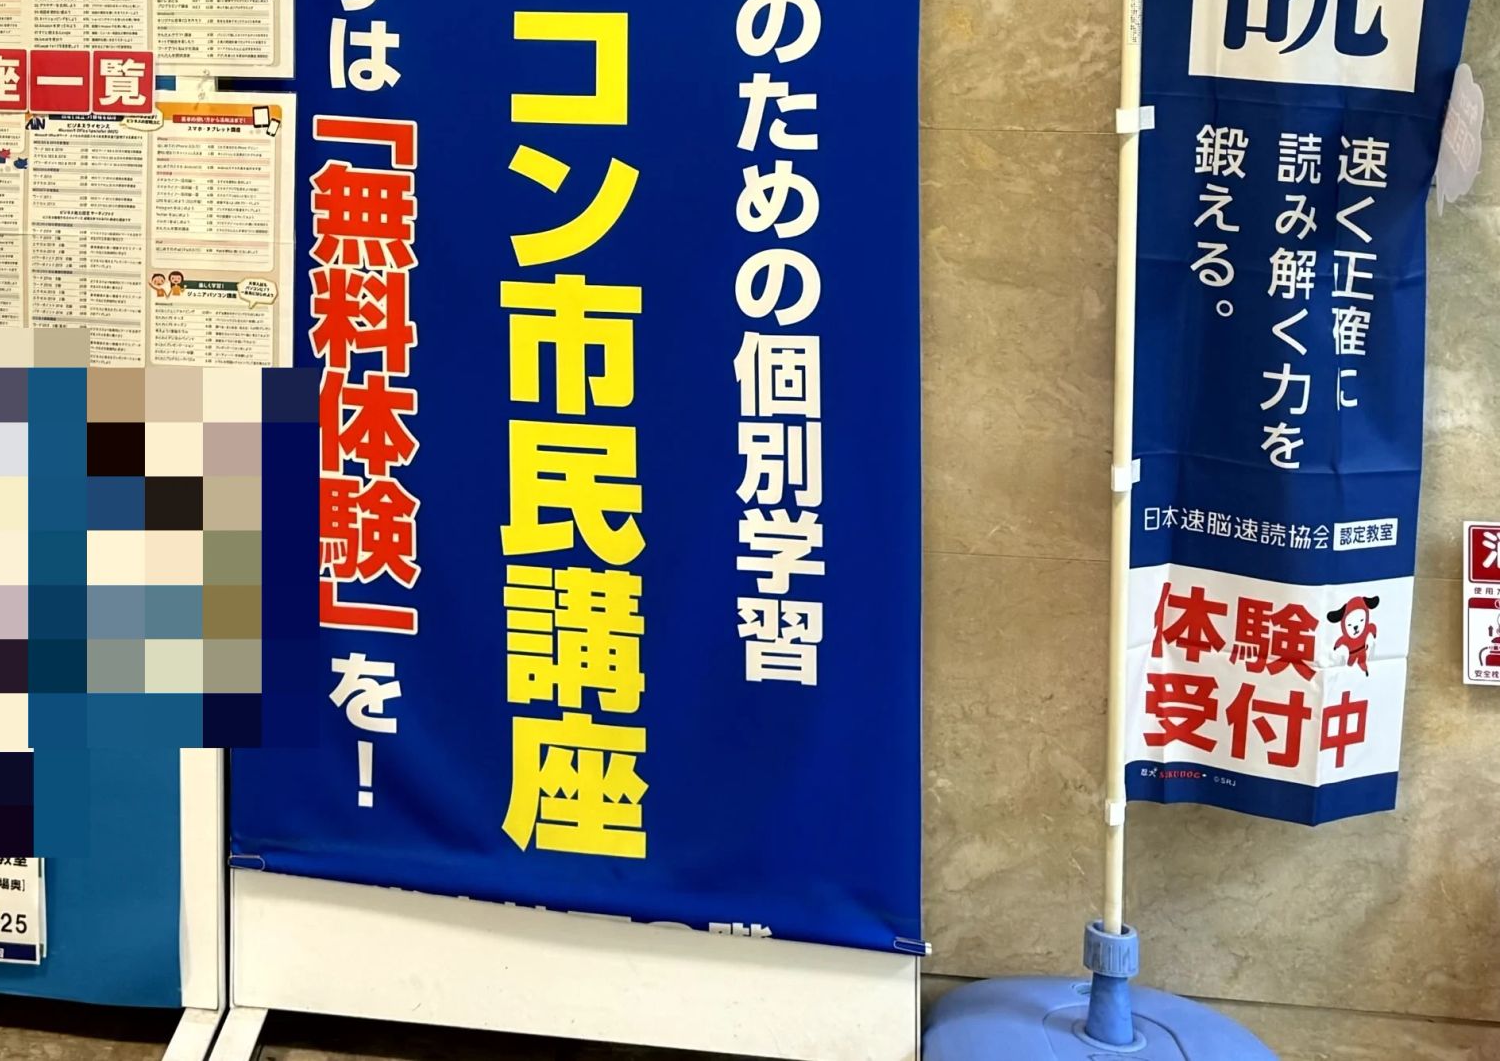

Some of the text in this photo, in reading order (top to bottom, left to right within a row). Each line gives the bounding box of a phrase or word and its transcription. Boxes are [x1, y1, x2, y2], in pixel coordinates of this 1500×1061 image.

[1190, 124, 1250, 319] 鍛える。
[1259, 131, 1324, 471] 読み解く力を
[1144, 505, 1395, 550] 日本速脳速読協会 認定教室
[1150, 581, 1320, 681] 体験
[1143, 672, 1370, 769] 受付中
